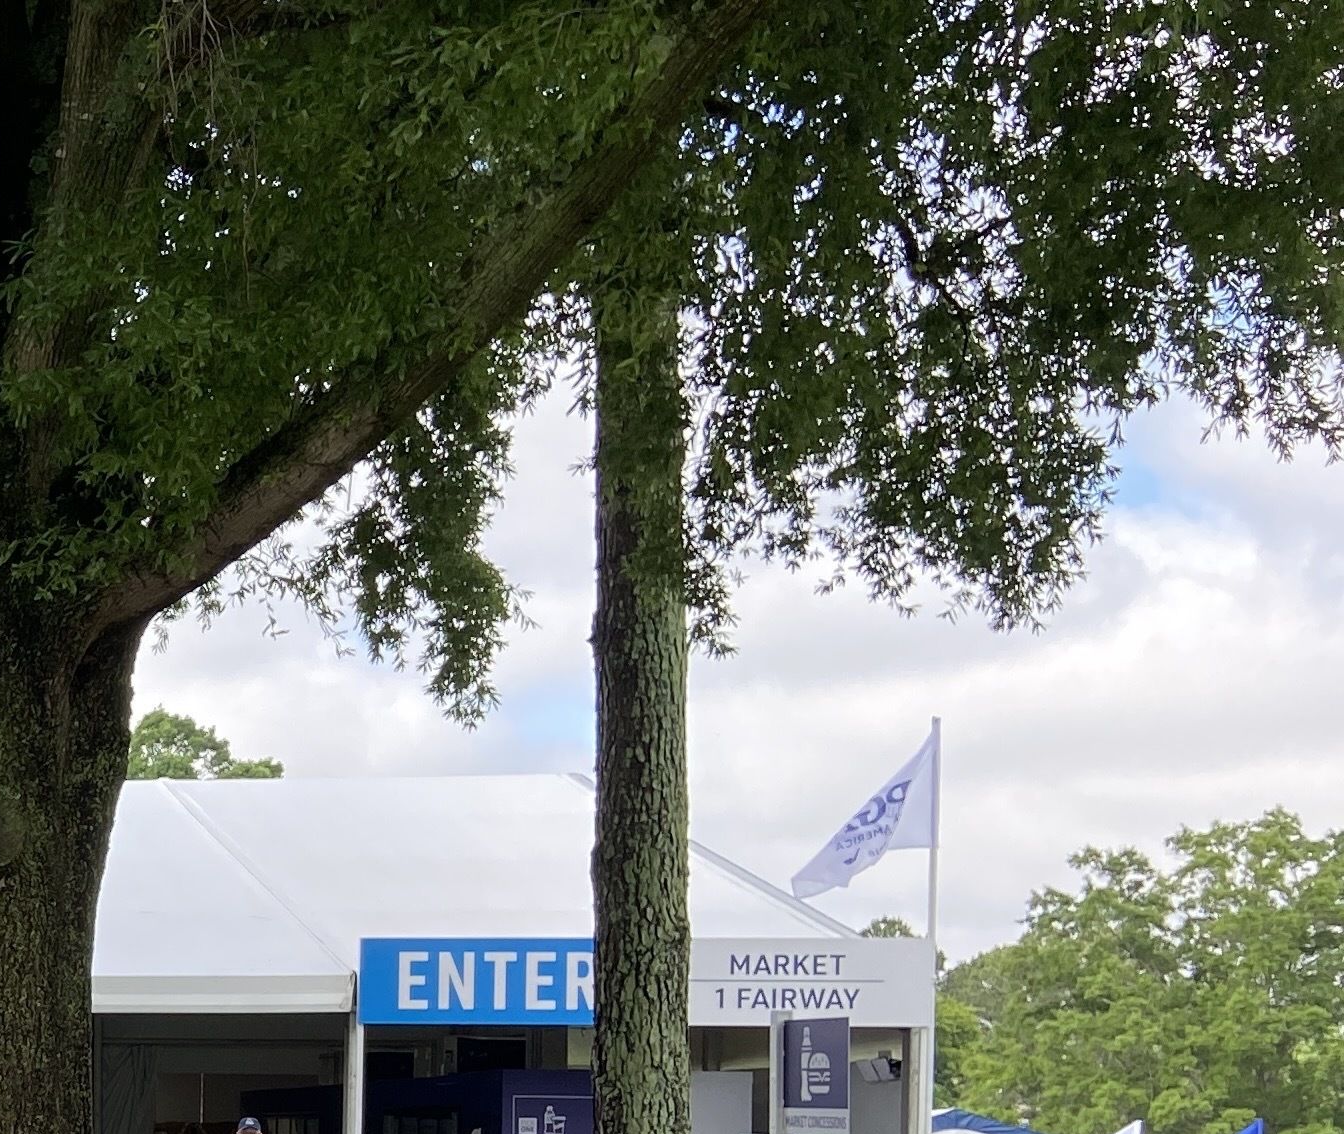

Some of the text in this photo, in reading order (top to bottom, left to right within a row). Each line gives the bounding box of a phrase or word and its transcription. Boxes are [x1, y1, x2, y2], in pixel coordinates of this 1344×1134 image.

[730, 954, 846, 975] MARKET
[398, 951, 594, 1010] ENTER
[715, 988, 860, 1009] 1 FAIRWAY
[785, 1115, 807, 1128] MARKET
